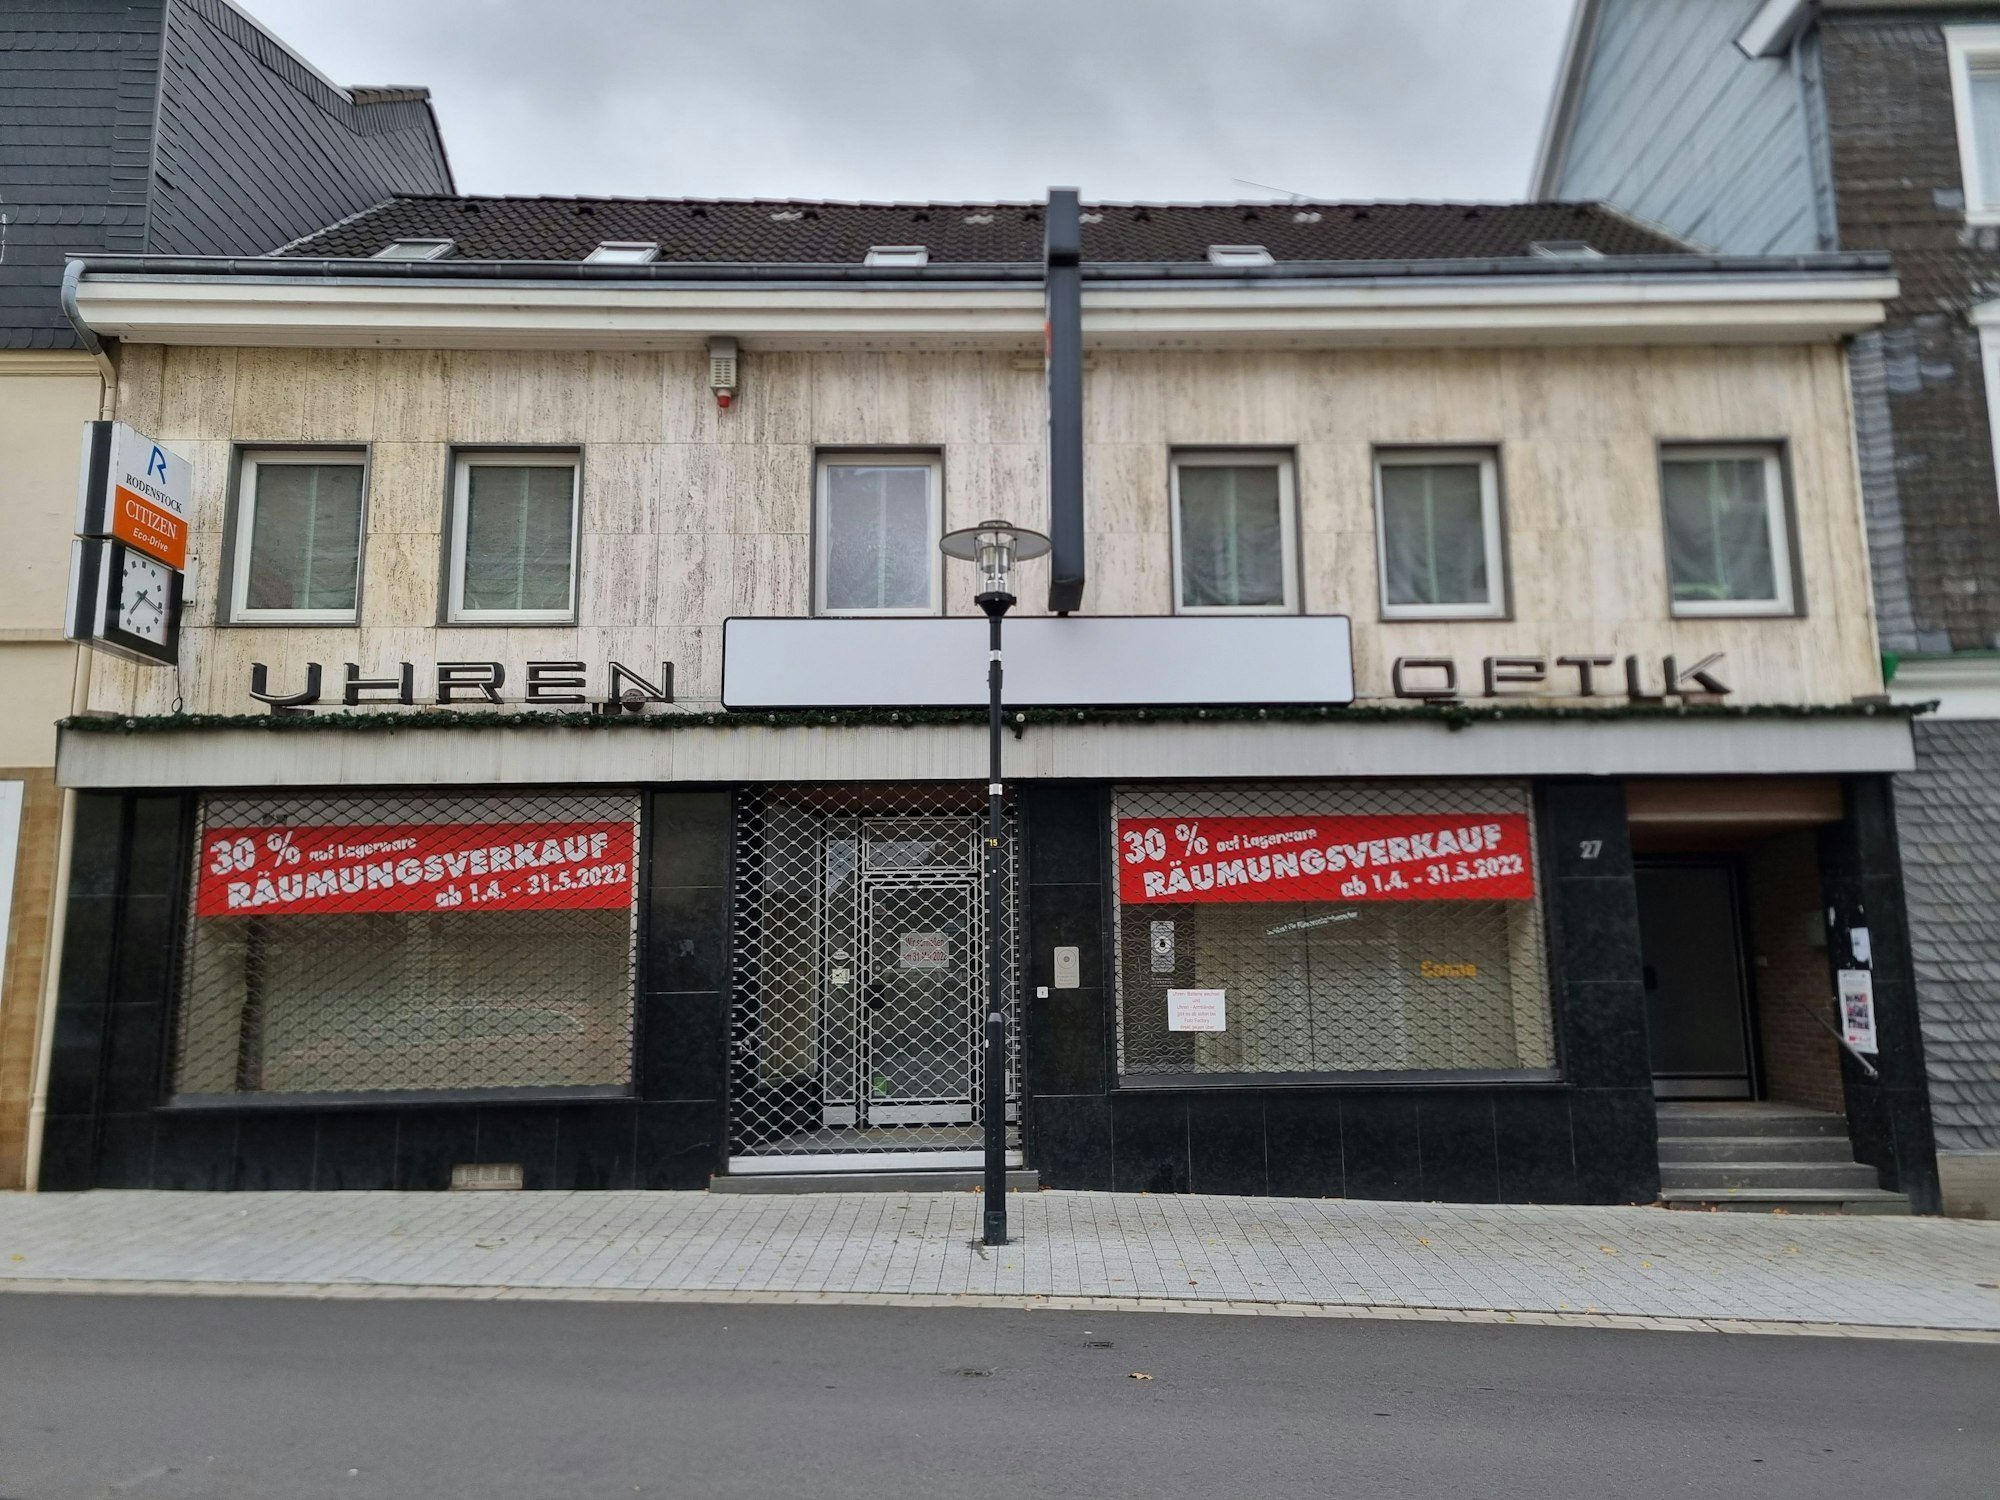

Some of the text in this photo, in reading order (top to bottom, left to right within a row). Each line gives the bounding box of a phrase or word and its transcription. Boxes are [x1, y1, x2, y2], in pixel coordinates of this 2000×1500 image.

[126, 473, 182, 513] RODENSTOCK
[125, 499, 178, 540] CITIZEN
[132, 527, 169, 552] Eco-Drive
[249, 660, 675, 705] UHREN
[1392, 652, 1732, 699] OPTIK
[210, 831, 417, 875] 30 % auf Lagerware
[989, 838, 998, 847] 15
[1123, 822, 1318, 865] 30 % auf Lagerware
[1143, 823, 1502, 898] RÄUMUNGSVERKAUF
[1579, 840, 1603, 859] 27
[227, 832, 608, 909] RÄUMUNGSVERKAUF
[435, 885, 463, 907] ab
[469, 880, 507, 903] 1.4.
[527, 863, 628, 895] 31.5.2022
[1341, 874, 1367, 897] ab
[1372, 870, 1410, 893] 1.4.
[1426, 854, 1525, 885] 31.5.2022
